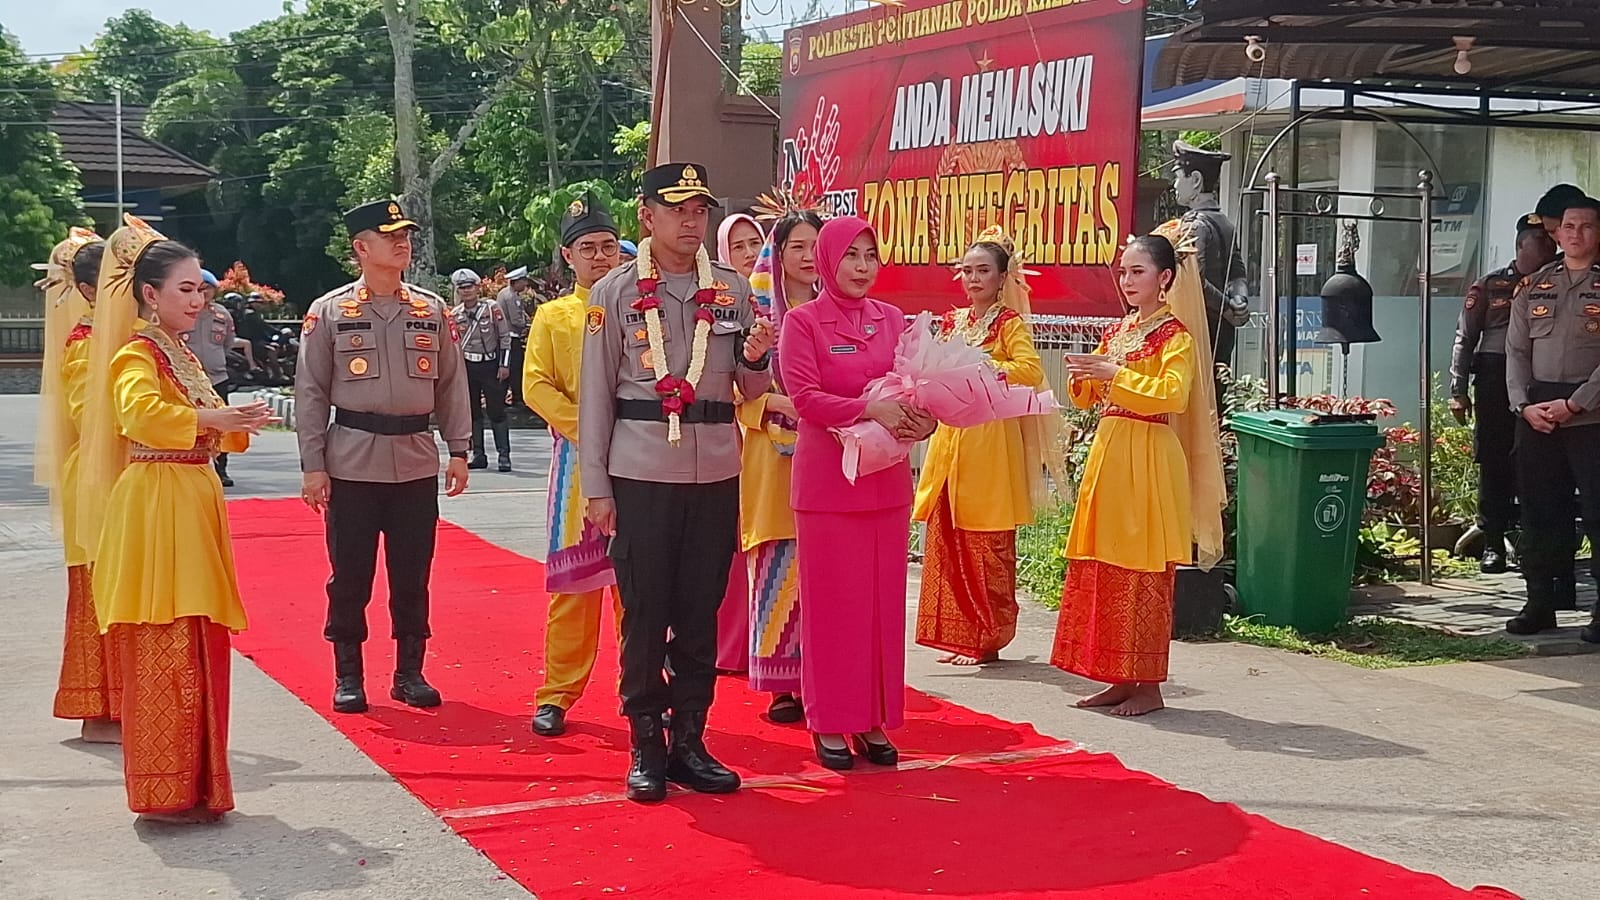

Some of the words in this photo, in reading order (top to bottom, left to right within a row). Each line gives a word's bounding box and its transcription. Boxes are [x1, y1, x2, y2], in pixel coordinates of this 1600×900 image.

[808, 22, 874, 60] POLRESTA
[889, 78, 951, 151] ANDA
[956, 55, 1093, 144] MEMASUKI
[864, 178, 929, 265] ZONA
[936, 162, 1120, 265] INTEGRITAS
[1433, 220, 1463, 233] ATM
[406, 321, 437, 331] POLRI
